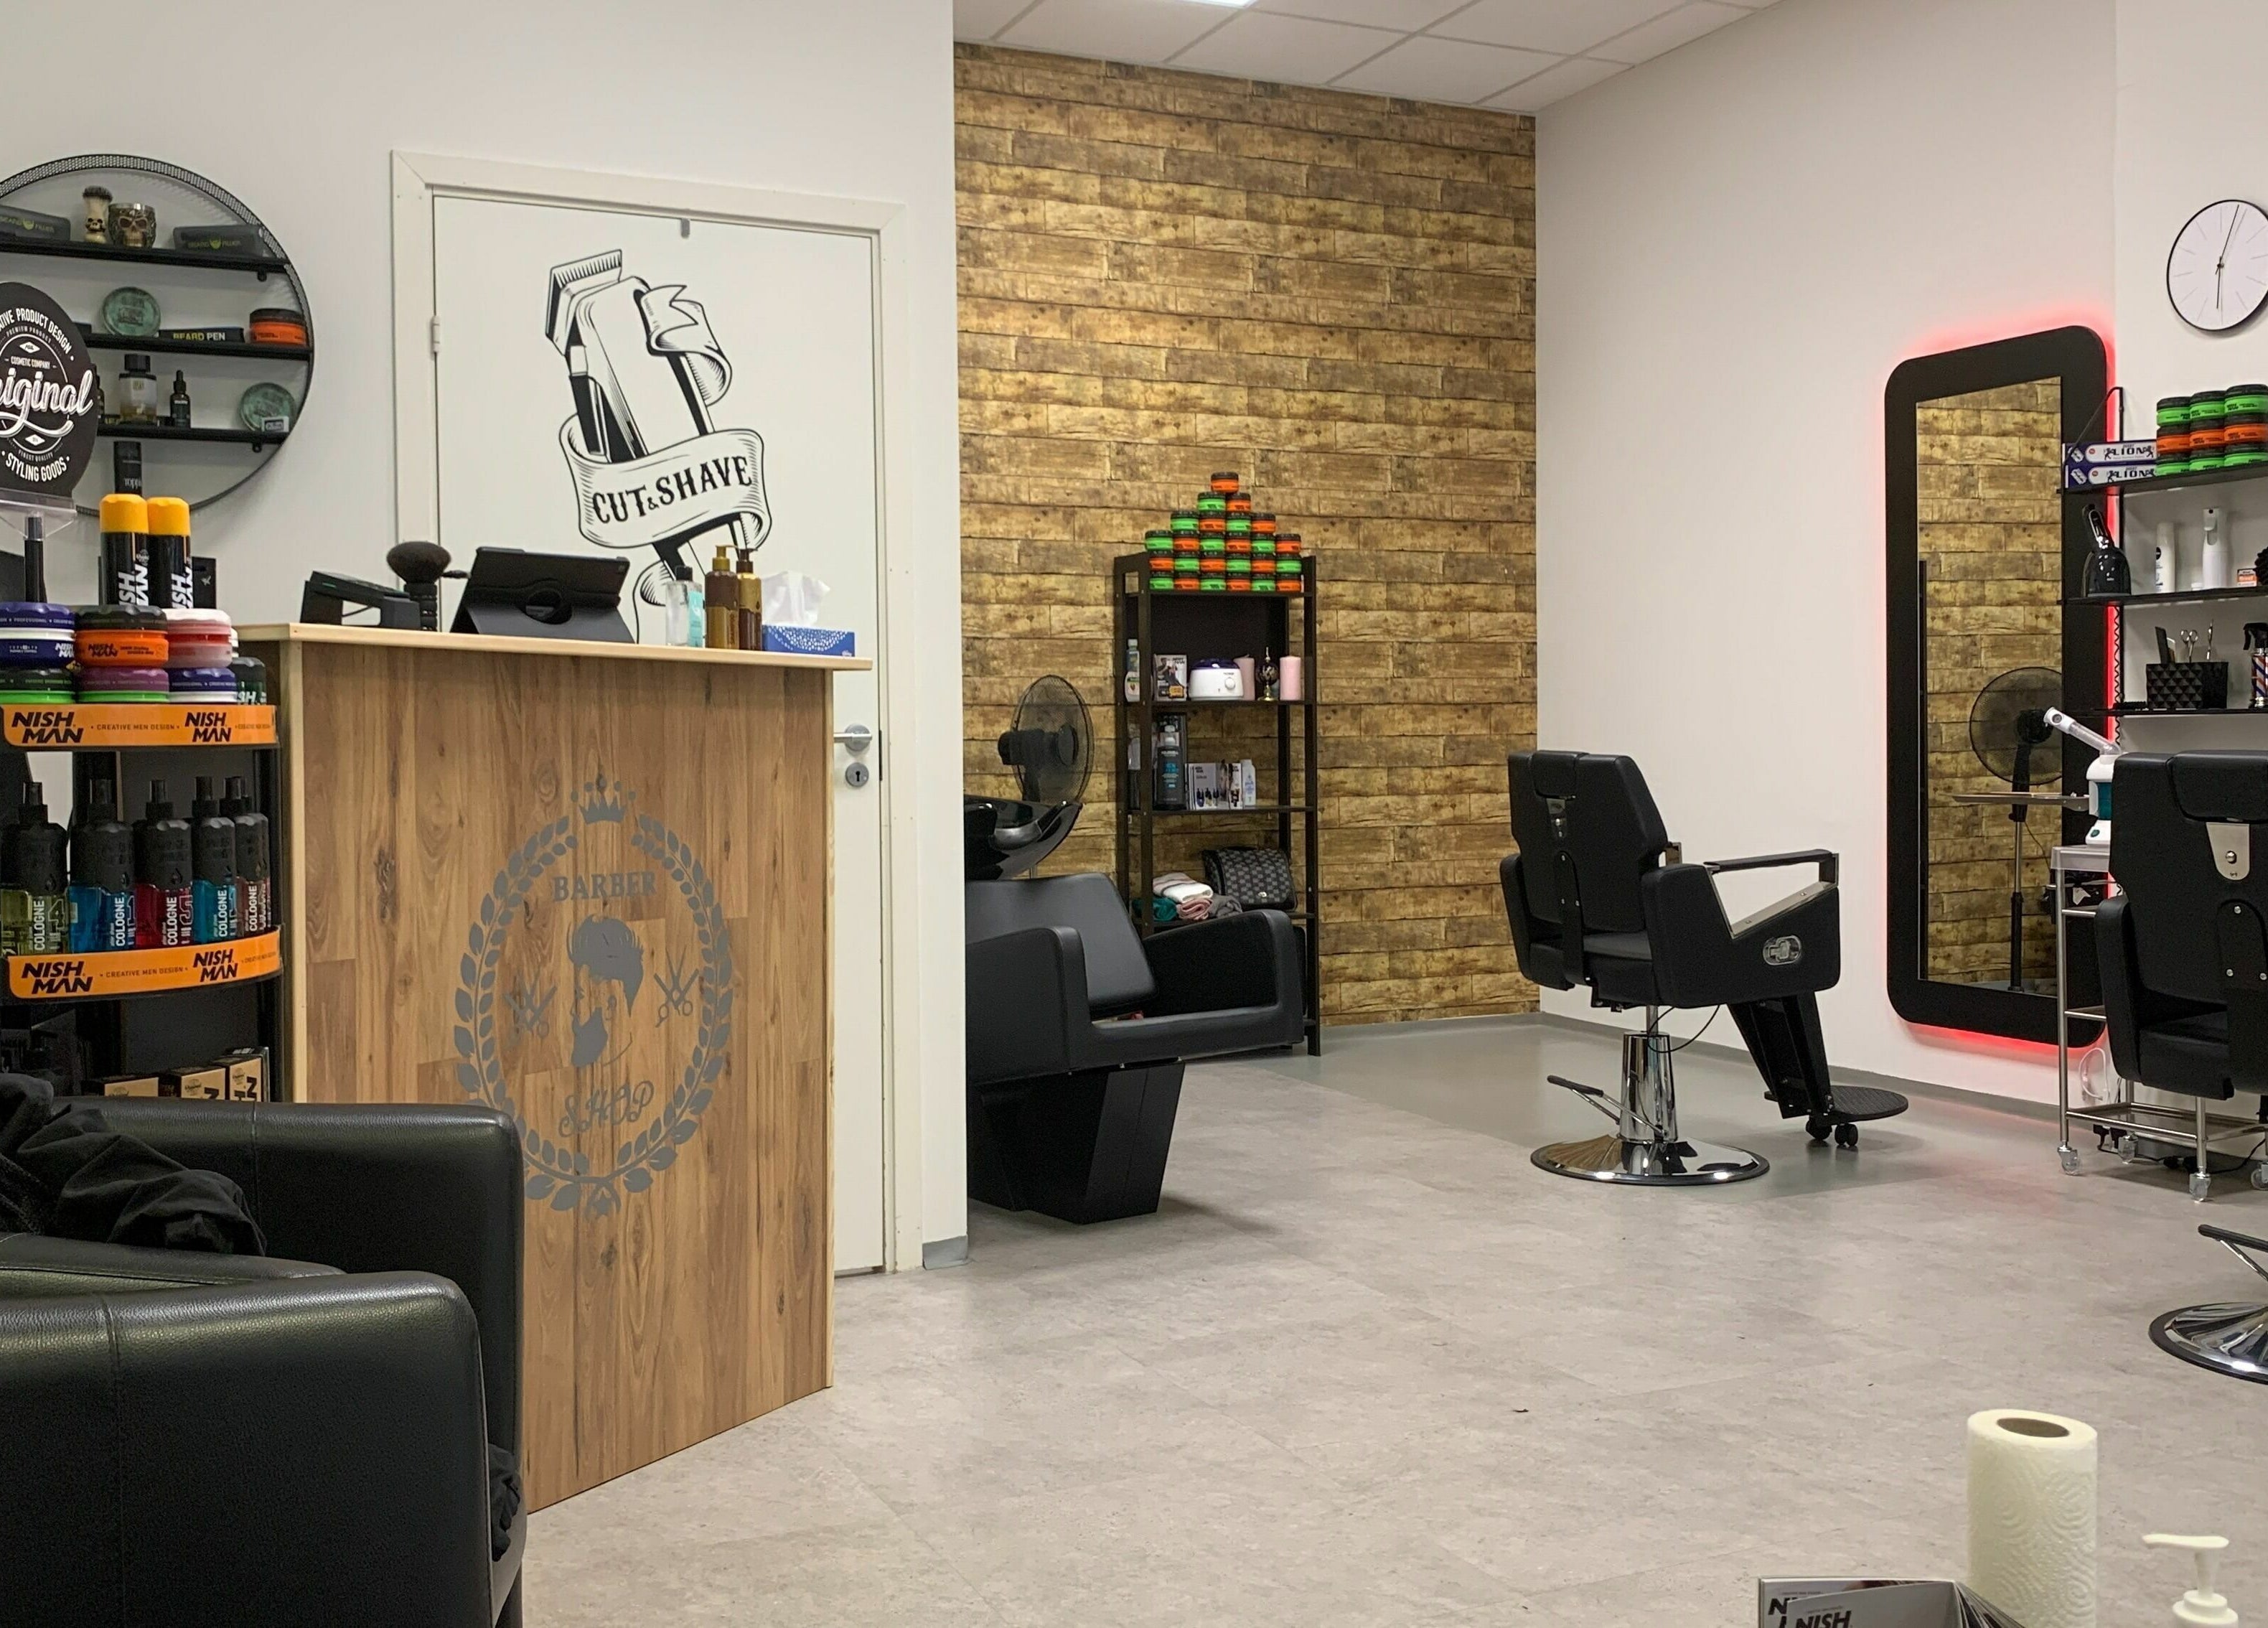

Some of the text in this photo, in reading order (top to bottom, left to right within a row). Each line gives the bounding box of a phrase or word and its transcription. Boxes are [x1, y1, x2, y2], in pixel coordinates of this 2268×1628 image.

[16, 308, 49, 329] PRODUCT
[47, 321, 72, 354] DESIGN
[206, 332, 225, 341] PEN
[6, 452, 67, 482] STYLING GOODS
[591, 485, 647, 523] CUT
[655, 456, 753, 505] SHAVE
[11, 711, 75, 728] NISH
[184, 711, 228, 728] NISH
[22, 727, 85, 744] MAN
[192, 727, 232, 743] MAN
[552, 871, 657, 902] BARBER
[217, 889, 228, 937] COLOGNE
[248, 885, 258, 932] COLOGNE
[33, 900, 45, 951] COLOGNE
[115, 897, 126, 947] COLOGNE
[166, 897, 178, 946] COLOGNE
[21, 960, 85, 978] NISH
[193, 948, 234, 968] NISH
[32, 976, 93, 994] MAN
[106, 969, 140, 978] CREATIVE
[200, 963, 238, 983] MAN
[558, 1080, 655, 1138] SHOP
